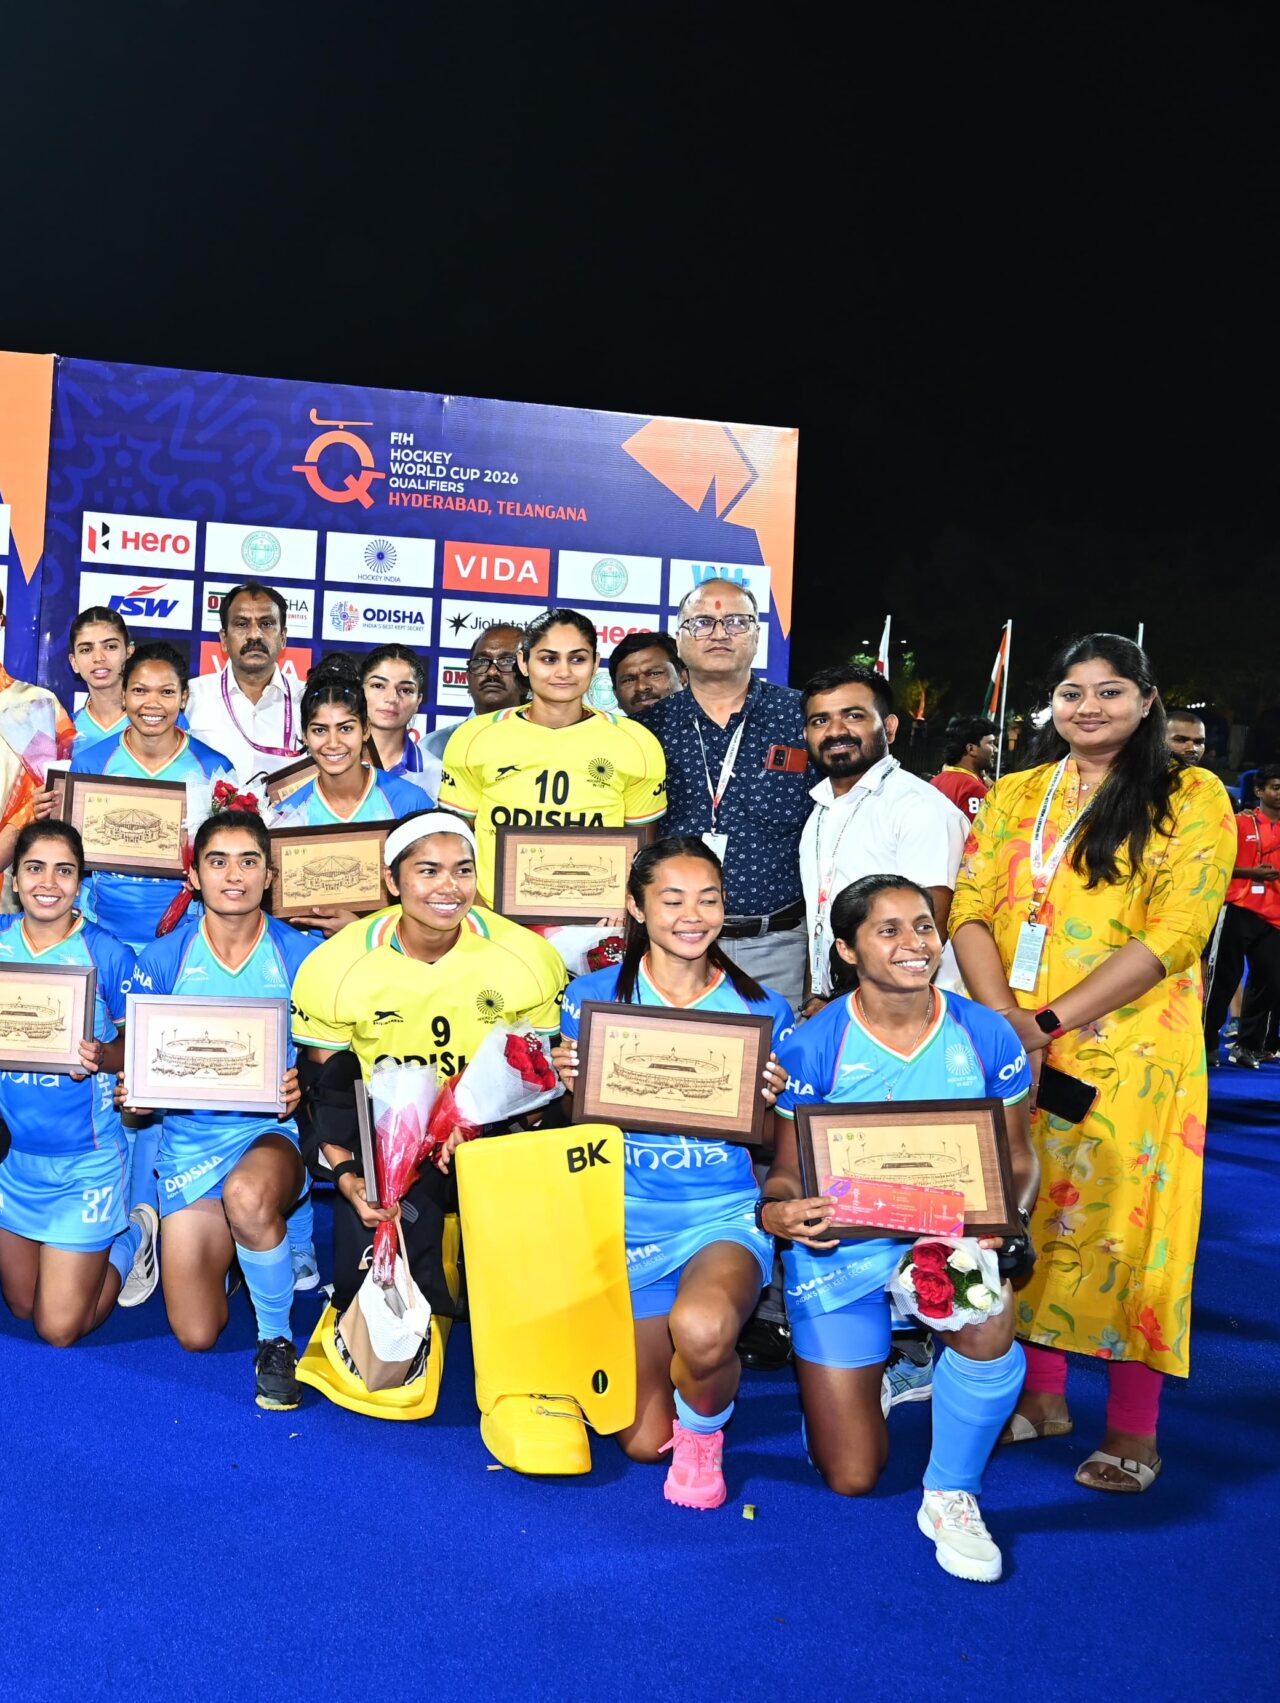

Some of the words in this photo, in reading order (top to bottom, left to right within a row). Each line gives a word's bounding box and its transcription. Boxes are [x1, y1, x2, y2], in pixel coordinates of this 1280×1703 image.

[390, 432, 414, 446] FIH
[390, 448, 453, 465] HOCKEY
[389, 477, 464, 493] QUALIFIERS
[390, 462, 446, 478] WORLD
[450, 466, 480, 481] CUP
[484, 470, 519, 485] 2026
[389, 492, 493, 516] HYDERABAD,
[497, 500, 588, 522] TELANGANA
[122, 530, 190, 554] Hero
[357, 573, 382, 581] HOCKEY
[384, 575, 401, 583] INDIA
[455, 554, 538, 584] VIDA
[363, 608, 425, 625] ODISHA
[443, 670, 467, 685] OM
[535, 769, 570, 805] 10
[491, 806, 604, 828] ODISHA
[431, 1016, 451, 1047] 9
[567, 1138, 611, 1173] BK
[165, 1155, 224, 1193] ODISHA
